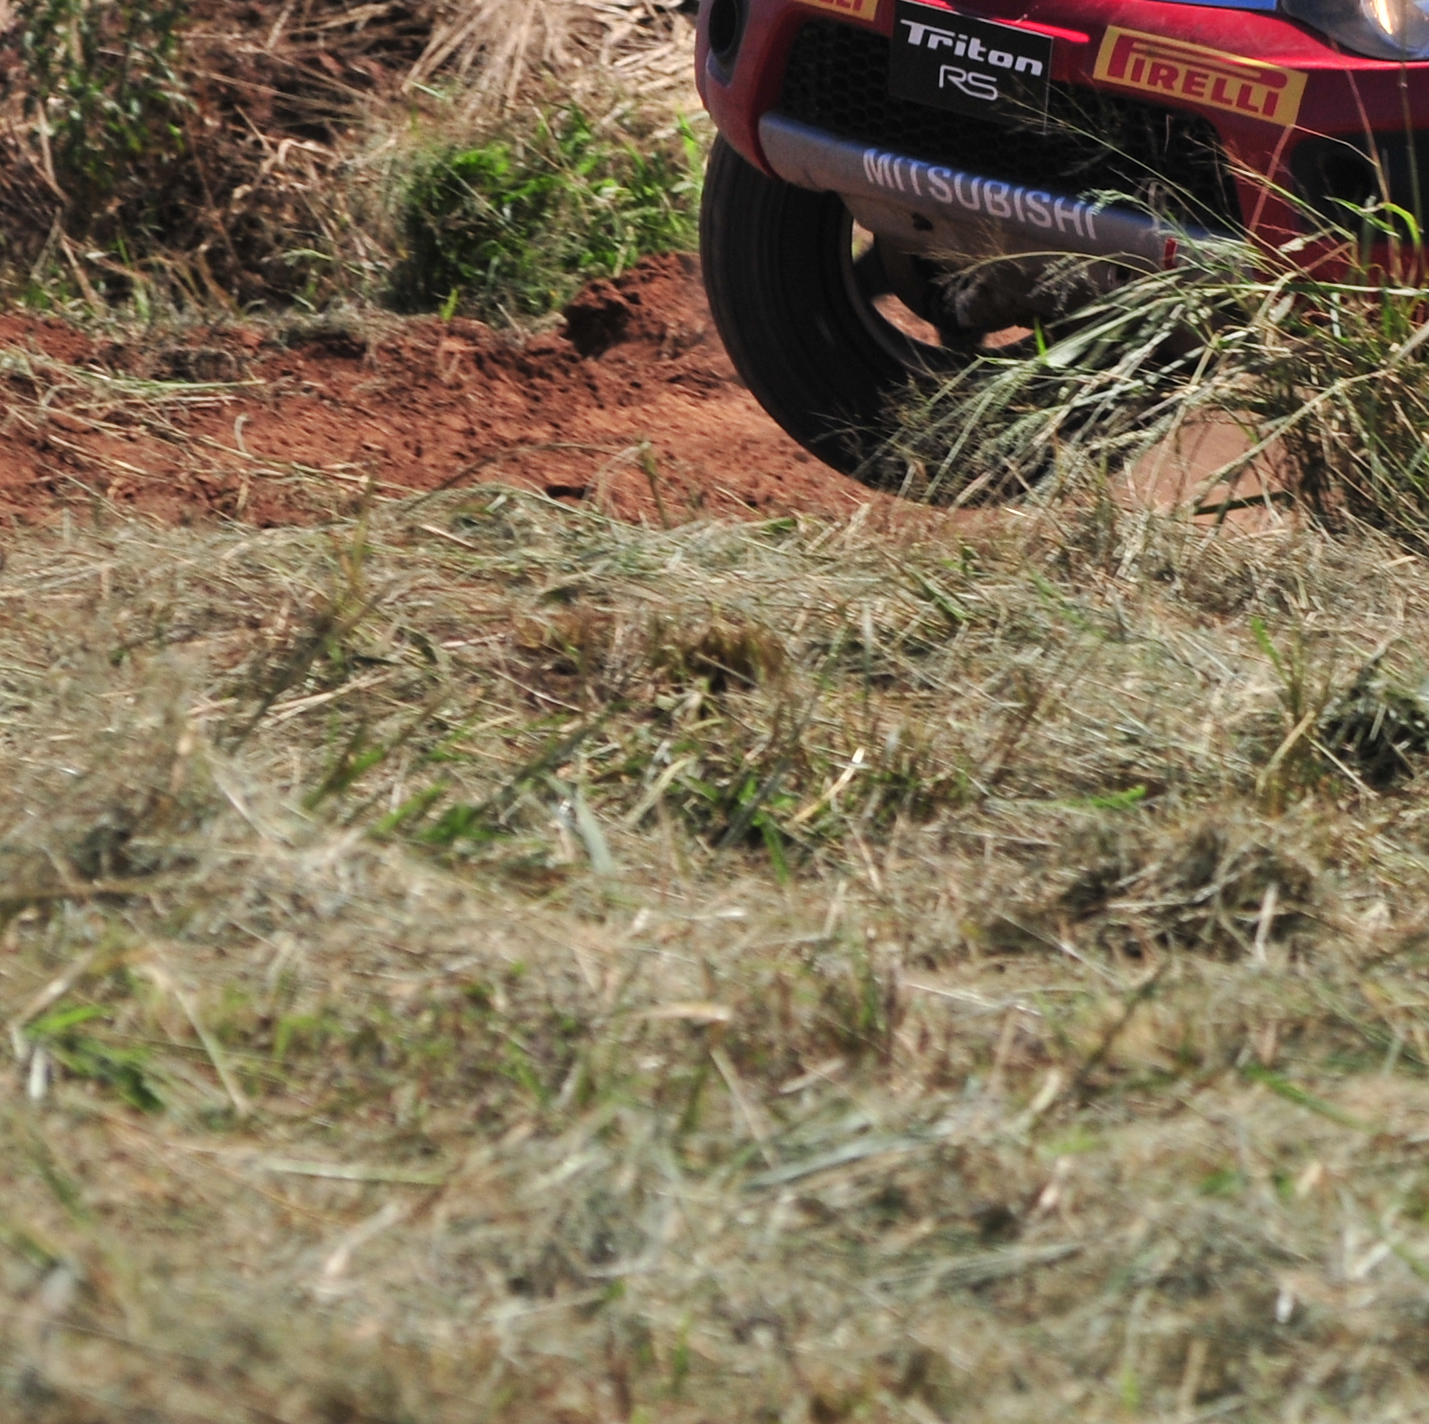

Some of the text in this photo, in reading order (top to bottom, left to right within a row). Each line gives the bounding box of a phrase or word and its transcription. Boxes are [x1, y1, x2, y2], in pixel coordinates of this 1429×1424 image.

[901, 19, 1043, 76] Triton
[938, 64, 998, 101] RS
[1107, 34, 1288, 118] PIRELLI
[863, 147, 1097, 240] MITSUBISHI
